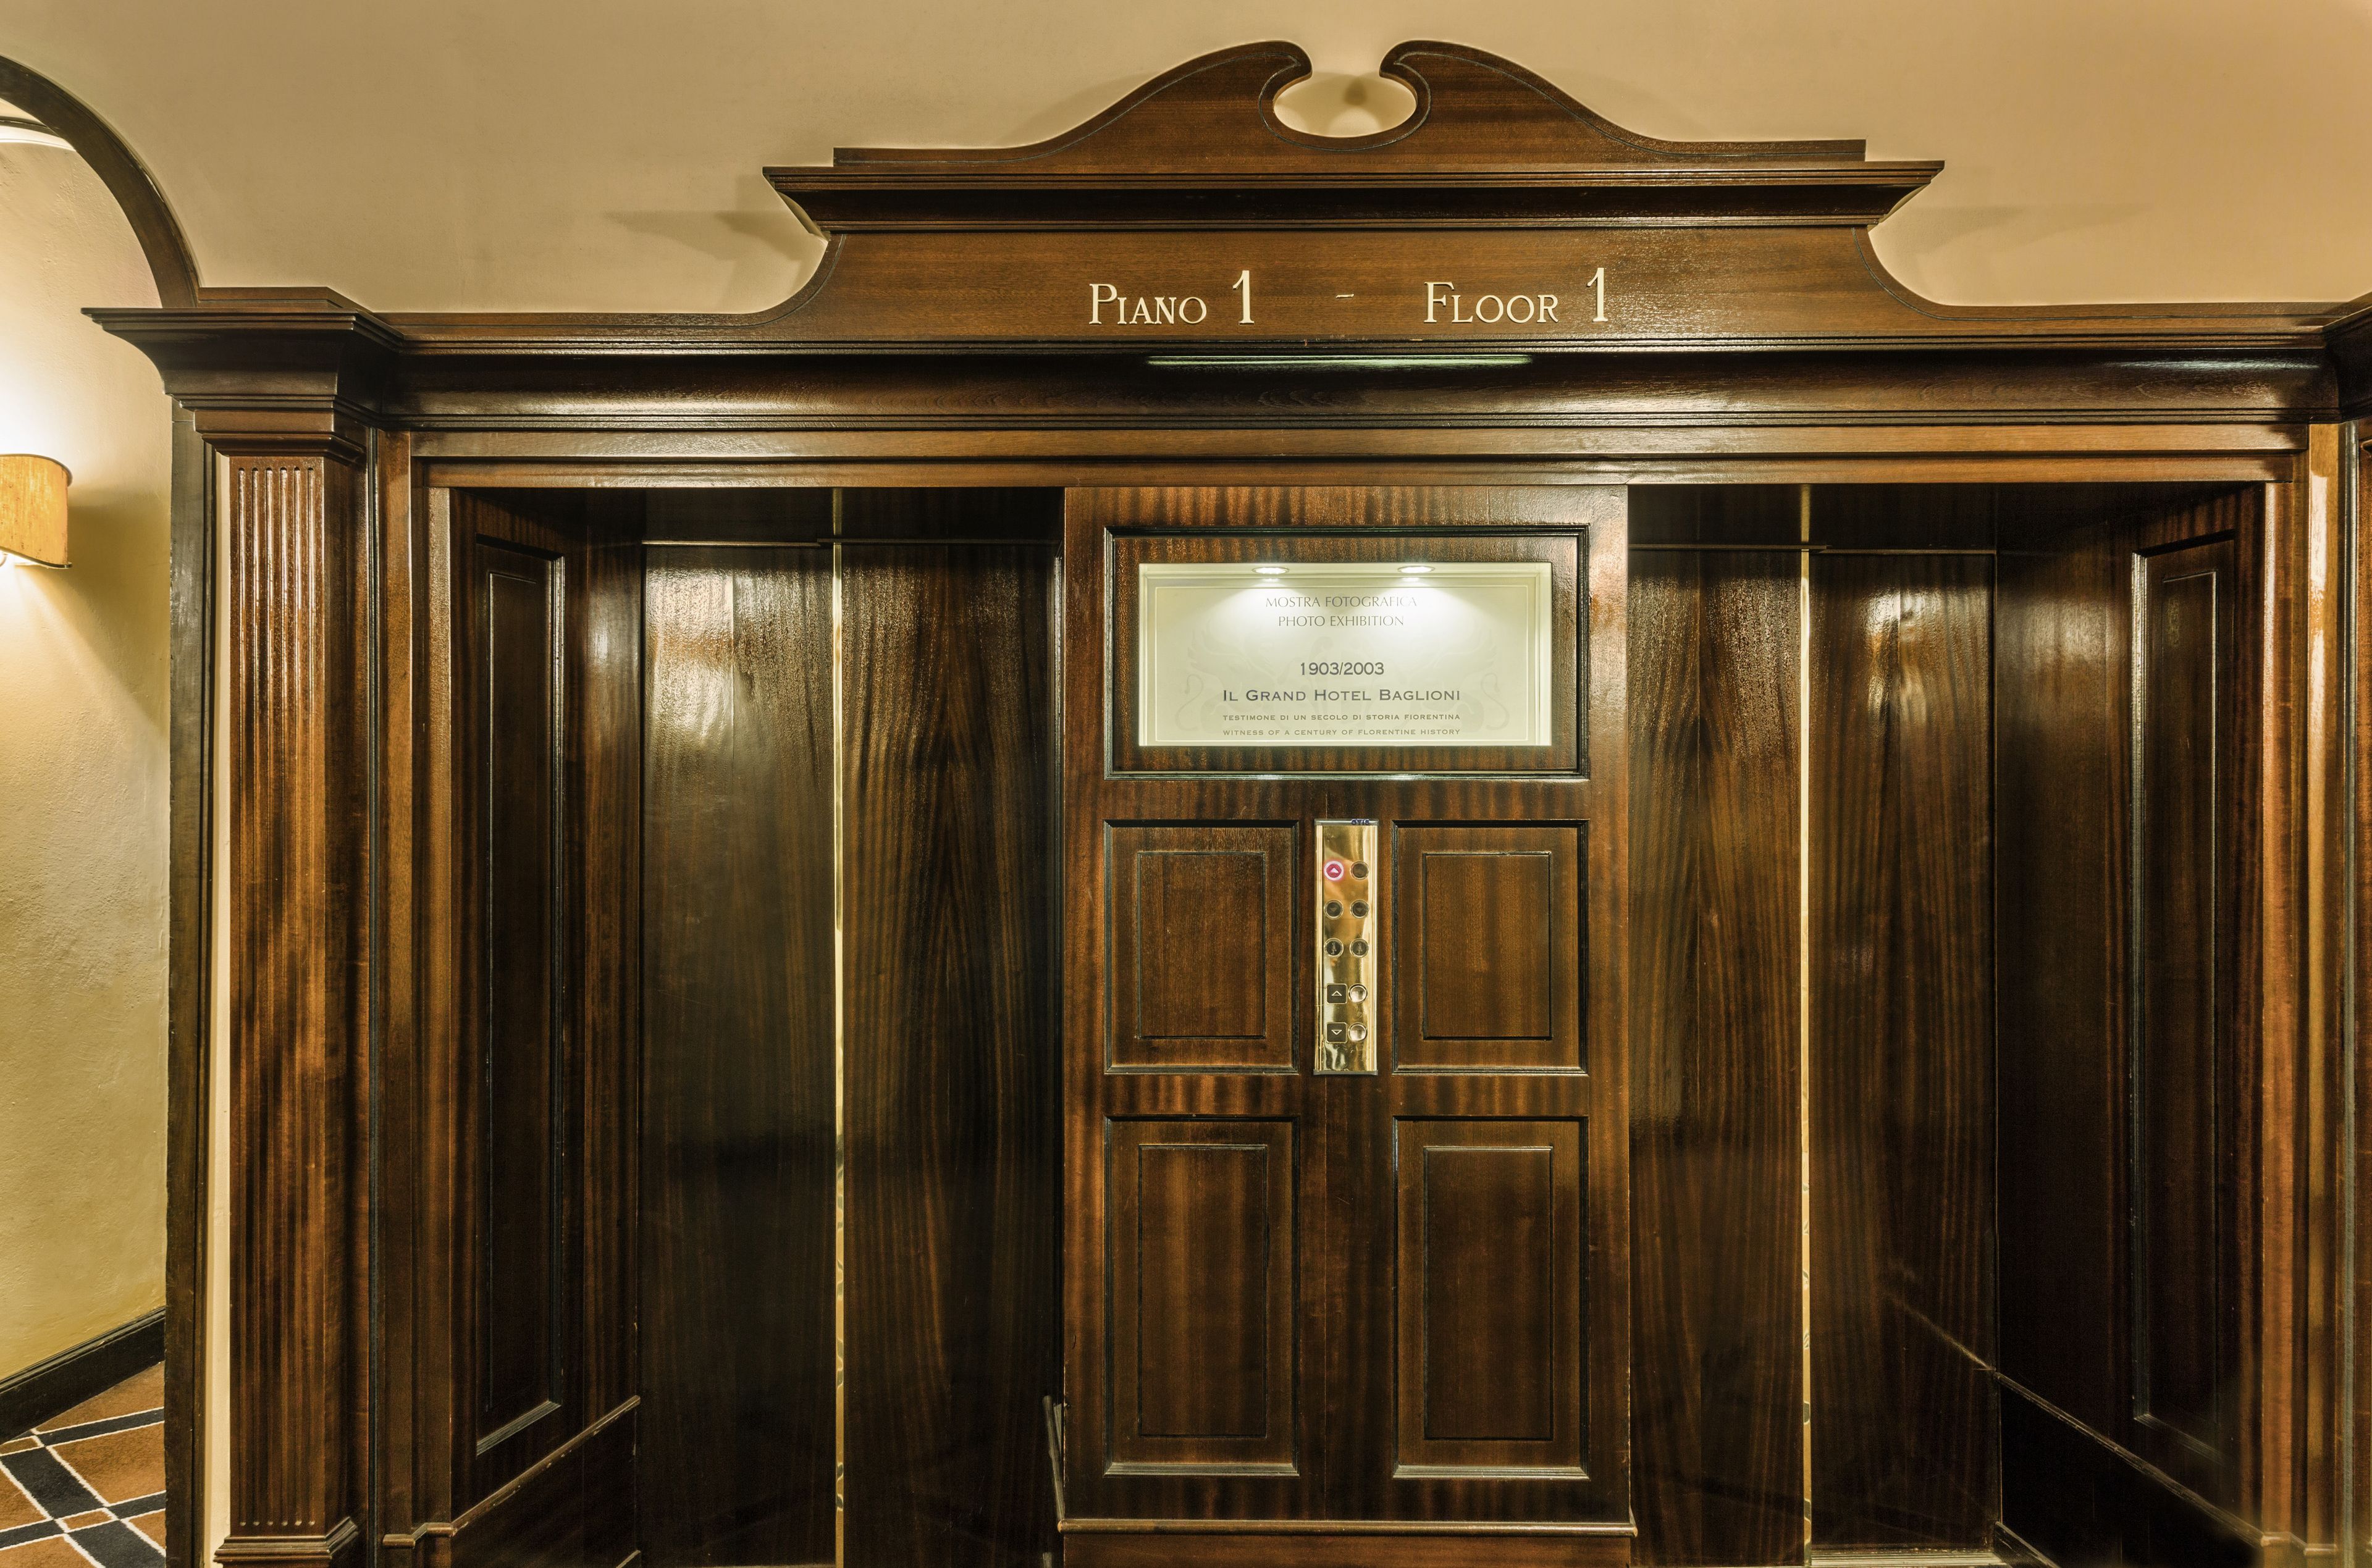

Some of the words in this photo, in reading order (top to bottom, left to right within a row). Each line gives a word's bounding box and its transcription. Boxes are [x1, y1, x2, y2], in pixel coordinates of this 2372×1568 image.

[1232, 270, 1255, 324] 1
[1587, 267, 1609, 323] 1
[1266, 597, 1321, 608] MOSTRA
[1325, 596, 1418, 608] FOTOGRAFICA
[1278, 616, 1326, 627] PHOTO
[1330, 616, 1404, 626] EXHIBITION
[1300, 661, 1385, 676] 1903/2003
